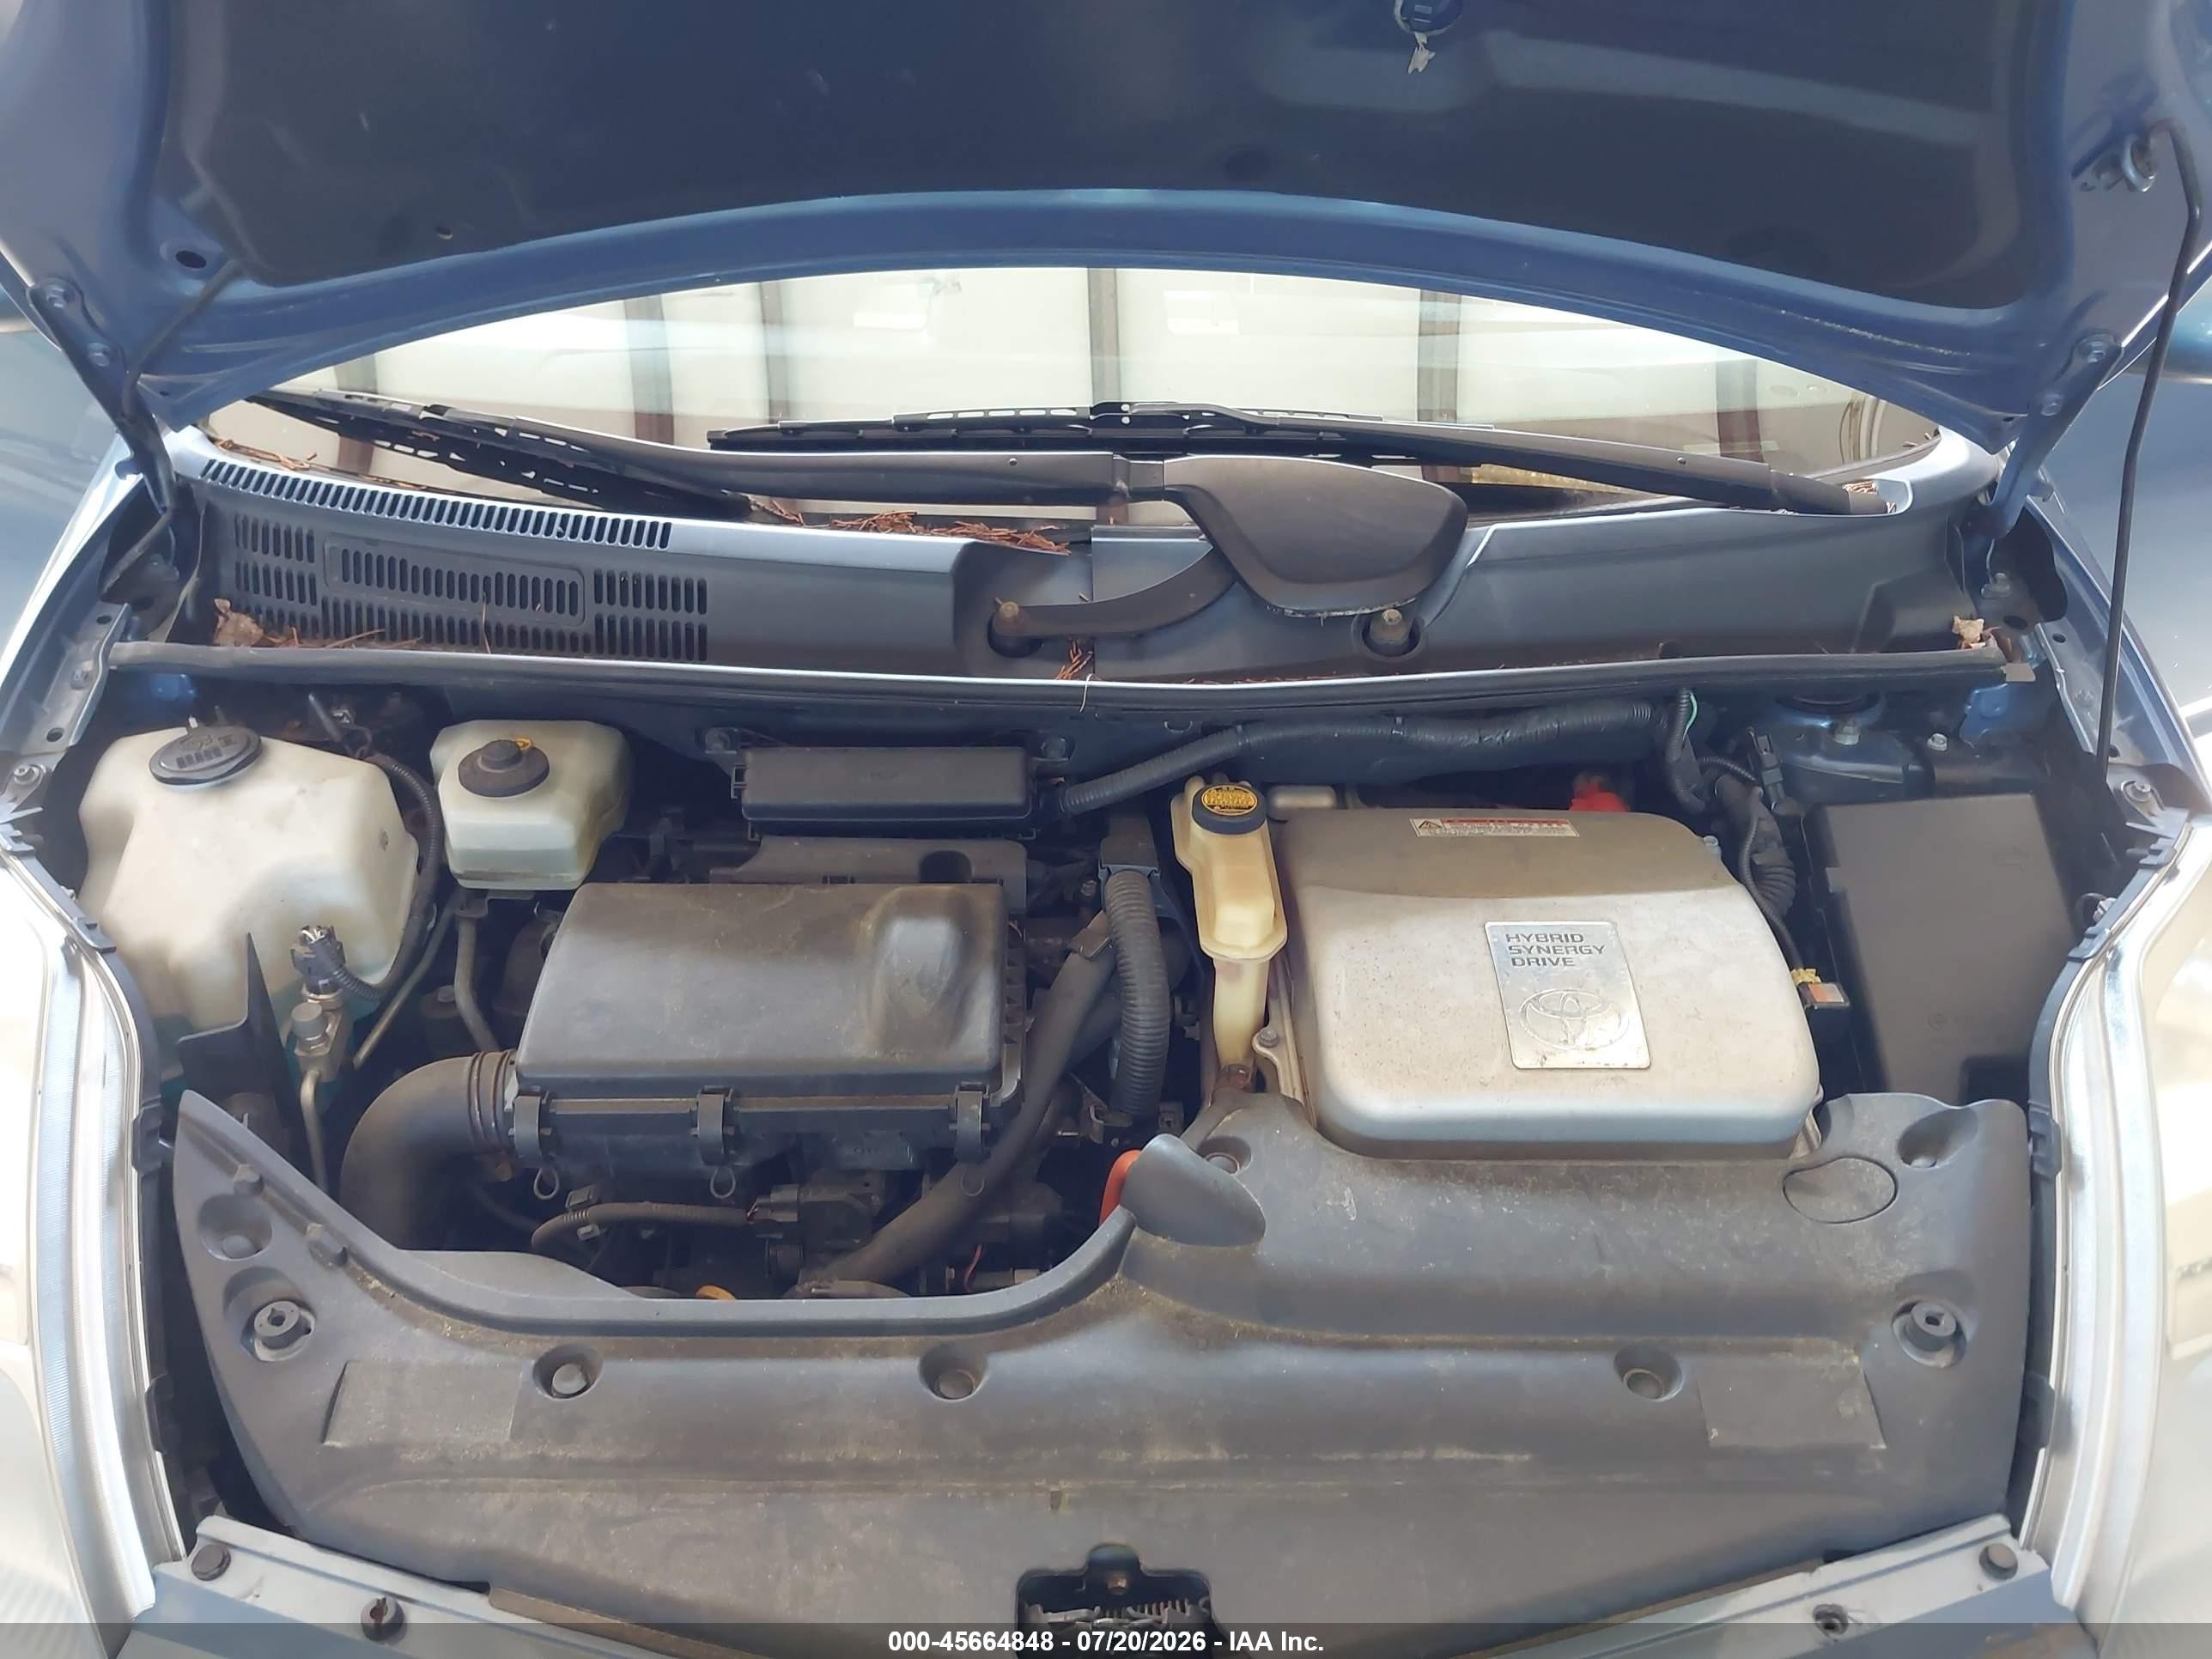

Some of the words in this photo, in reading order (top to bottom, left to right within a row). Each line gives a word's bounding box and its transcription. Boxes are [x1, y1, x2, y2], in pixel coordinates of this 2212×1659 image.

[1505, 933, 1583, 943] HYBRID
[1508, 945, 1605, 955] SYNERGY
[1511, 957, 1576, 967] DRIVE
